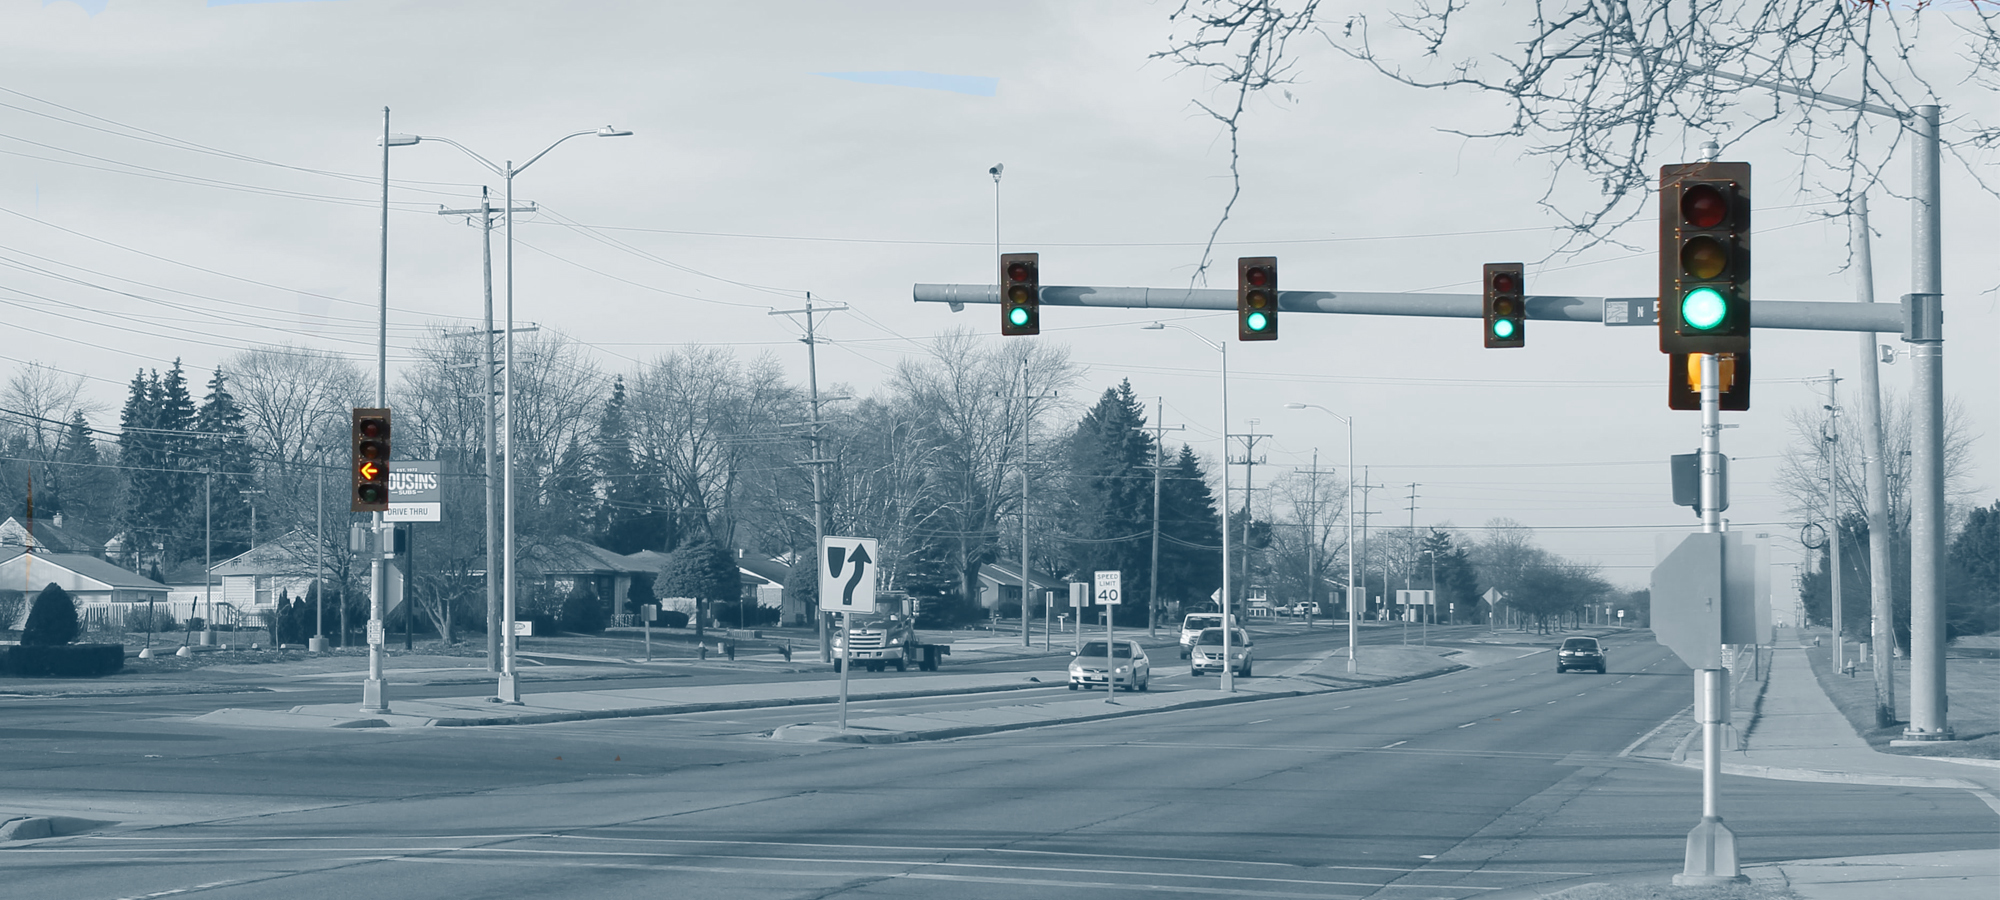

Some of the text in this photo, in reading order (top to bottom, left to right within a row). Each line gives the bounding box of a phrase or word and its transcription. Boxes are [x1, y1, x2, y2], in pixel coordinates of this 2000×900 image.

[1637, 306, 1644, 318] N
[388, 472, 437, 490] OUSINS
[1097, 589, 1118, 601] 40
